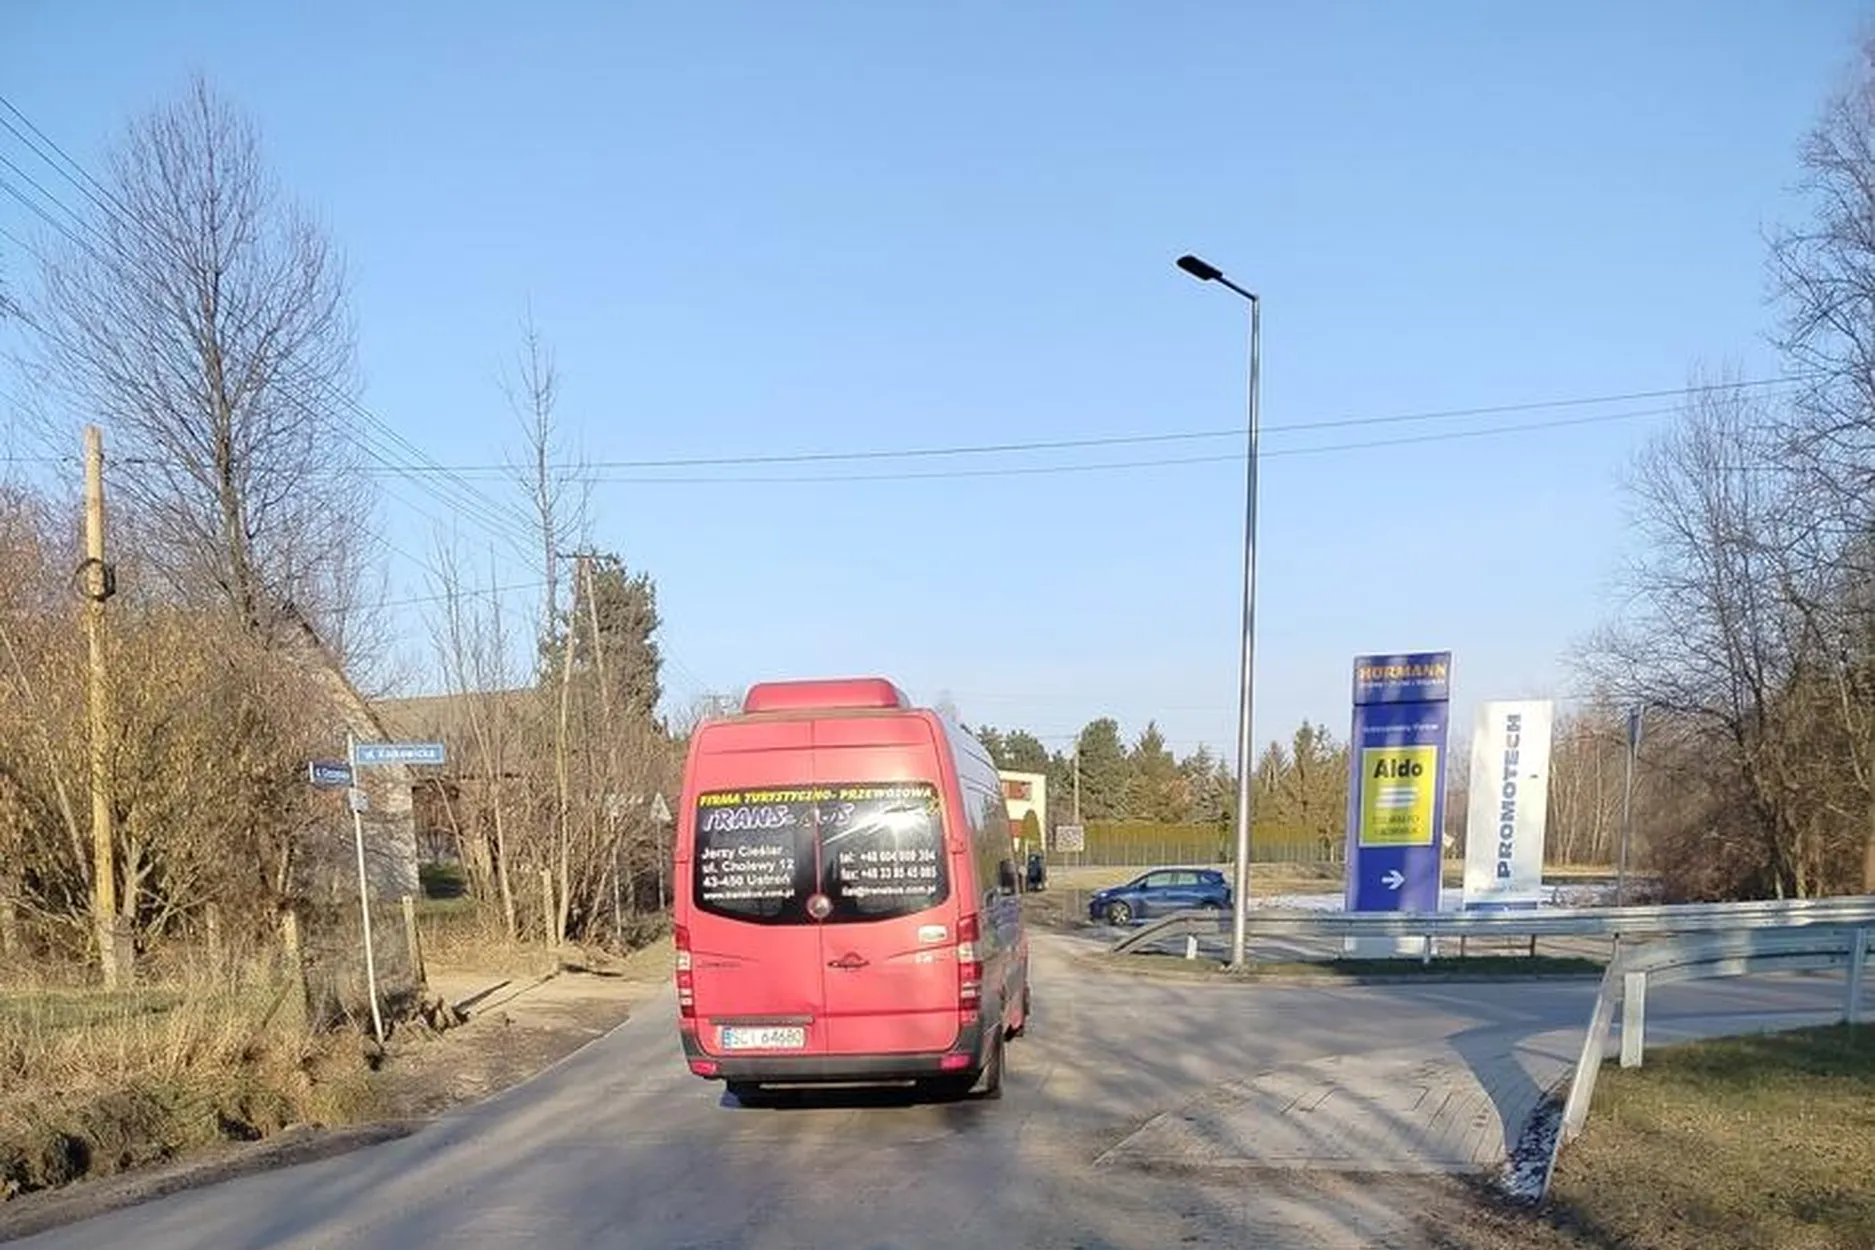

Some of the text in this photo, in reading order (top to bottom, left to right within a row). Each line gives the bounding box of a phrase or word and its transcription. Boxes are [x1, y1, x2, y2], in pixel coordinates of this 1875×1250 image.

[700, 793, 741, 806] FIRMA
[1497, 713, 1521, 878] PROMOTECH
[780, 858, 795, 869] 12
